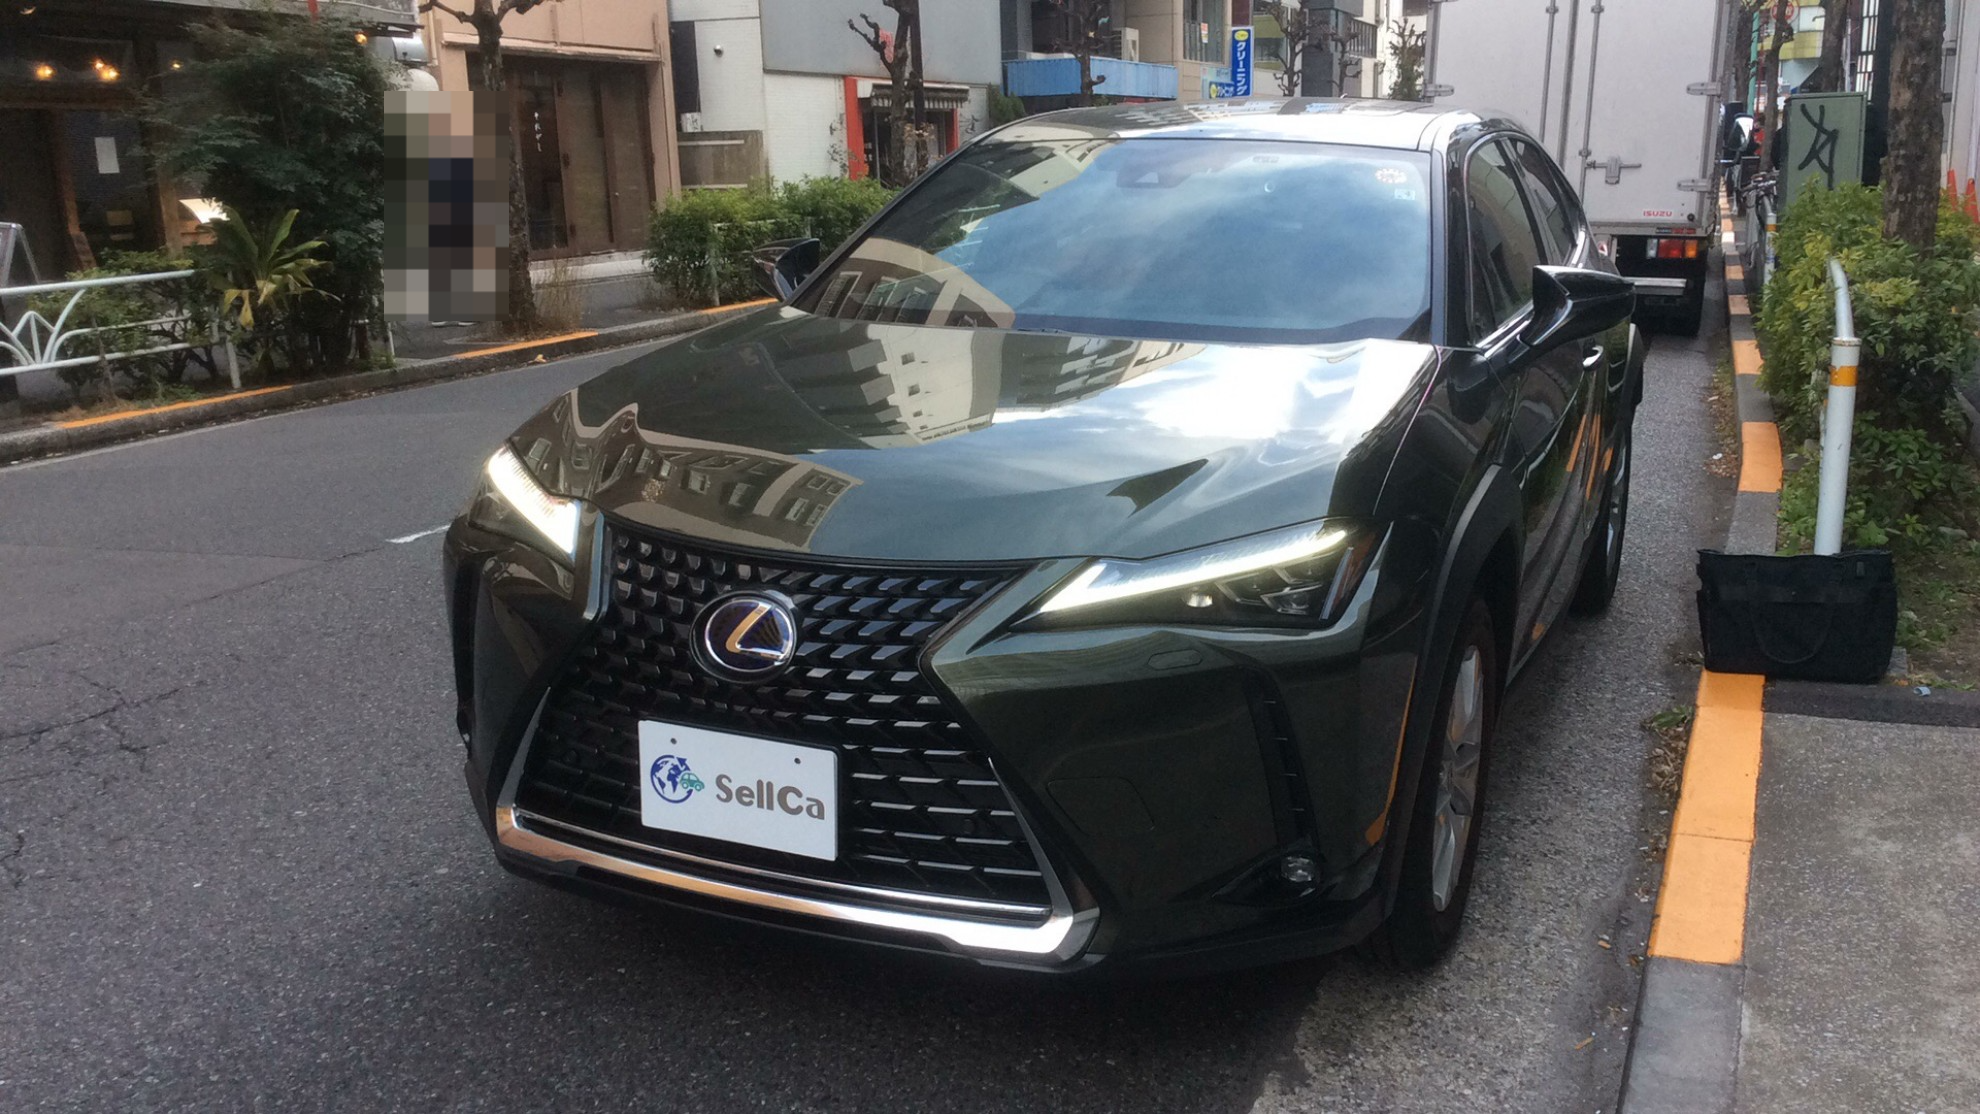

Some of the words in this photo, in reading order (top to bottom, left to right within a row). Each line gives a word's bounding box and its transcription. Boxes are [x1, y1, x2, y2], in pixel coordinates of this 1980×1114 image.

[1236, 41, 1248, 96] クリーニング
[715, 773, 825, 820] SellCa
